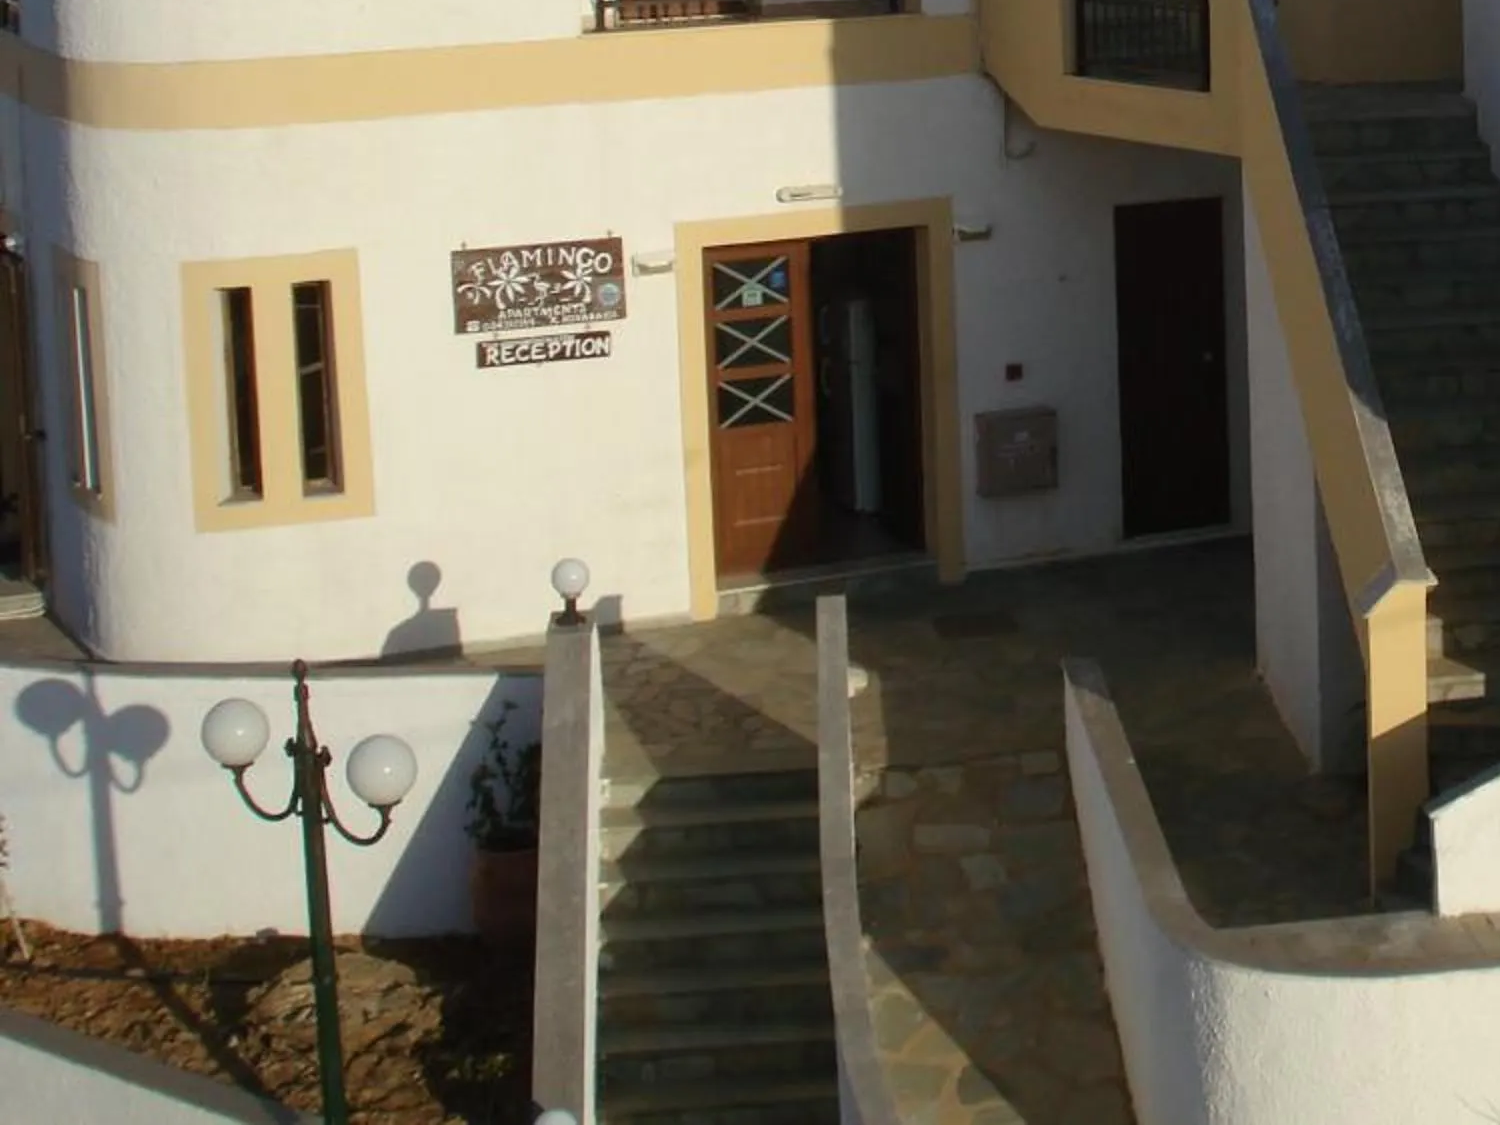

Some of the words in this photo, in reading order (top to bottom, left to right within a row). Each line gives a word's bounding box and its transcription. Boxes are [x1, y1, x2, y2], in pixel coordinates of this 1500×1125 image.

[470, 246, 613, 284] FLAMINGO
[498, 303, 587, 320] APARTMENTS
[484, 336, 610, 366] RECEPTION
